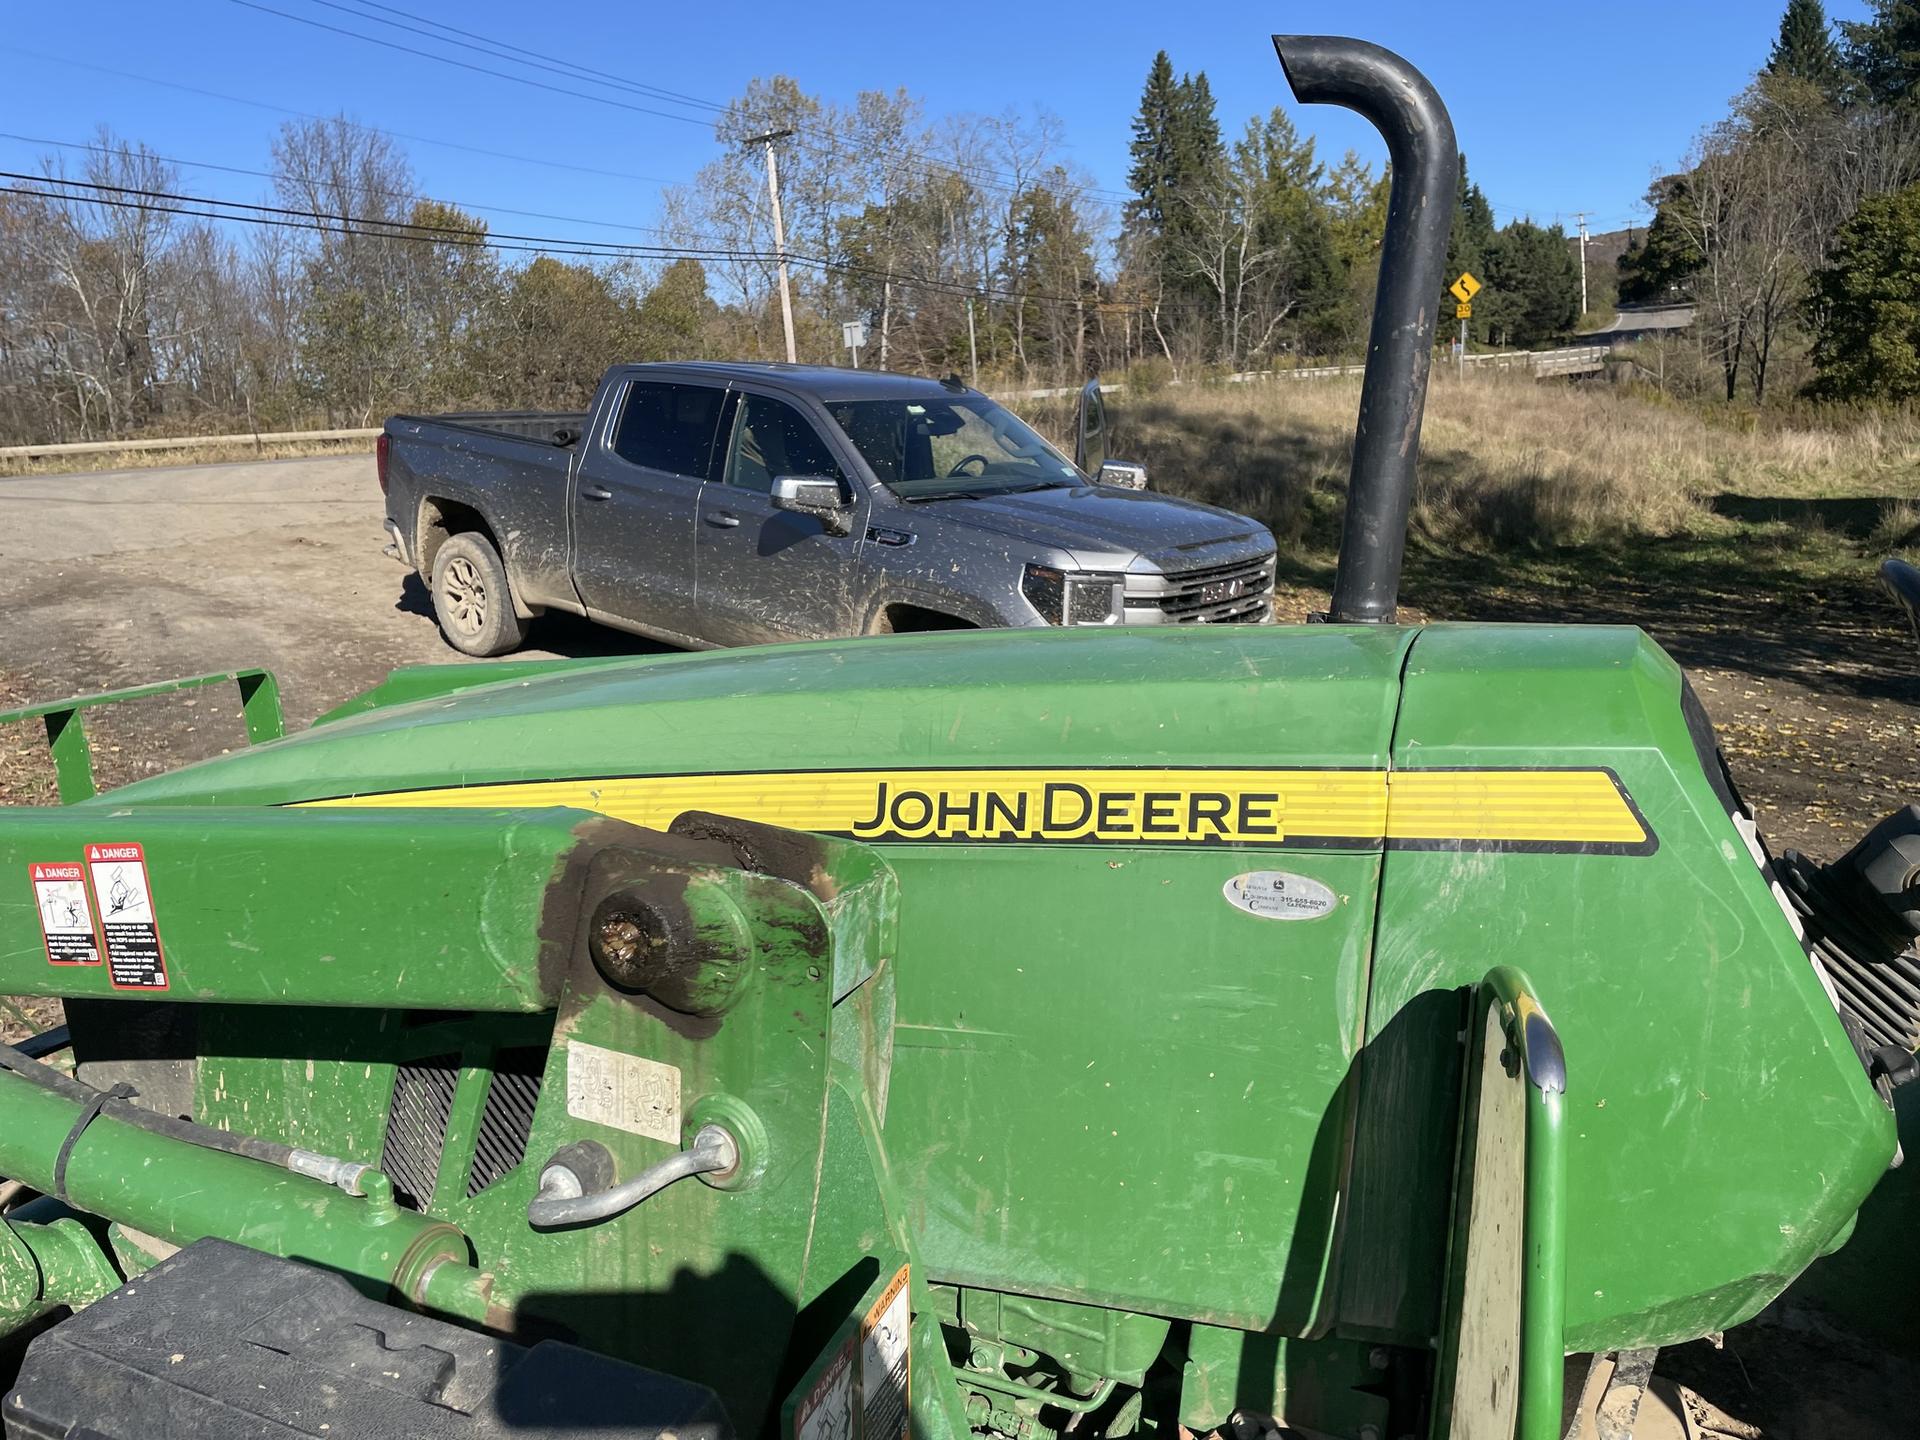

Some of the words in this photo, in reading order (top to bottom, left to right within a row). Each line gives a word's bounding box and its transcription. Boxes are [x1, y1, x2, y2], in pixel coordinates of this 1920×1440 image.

[852, 781, 1028, 834] JOHN
[1042, 782, 1279, 836] DEERE
[45, 868, 80, 878] DANGER
[102, 848, 139, 859] DANGER
[874, 1268, 908, 1319] WARNING
[814, 1349, 849, 1404] DANGE
